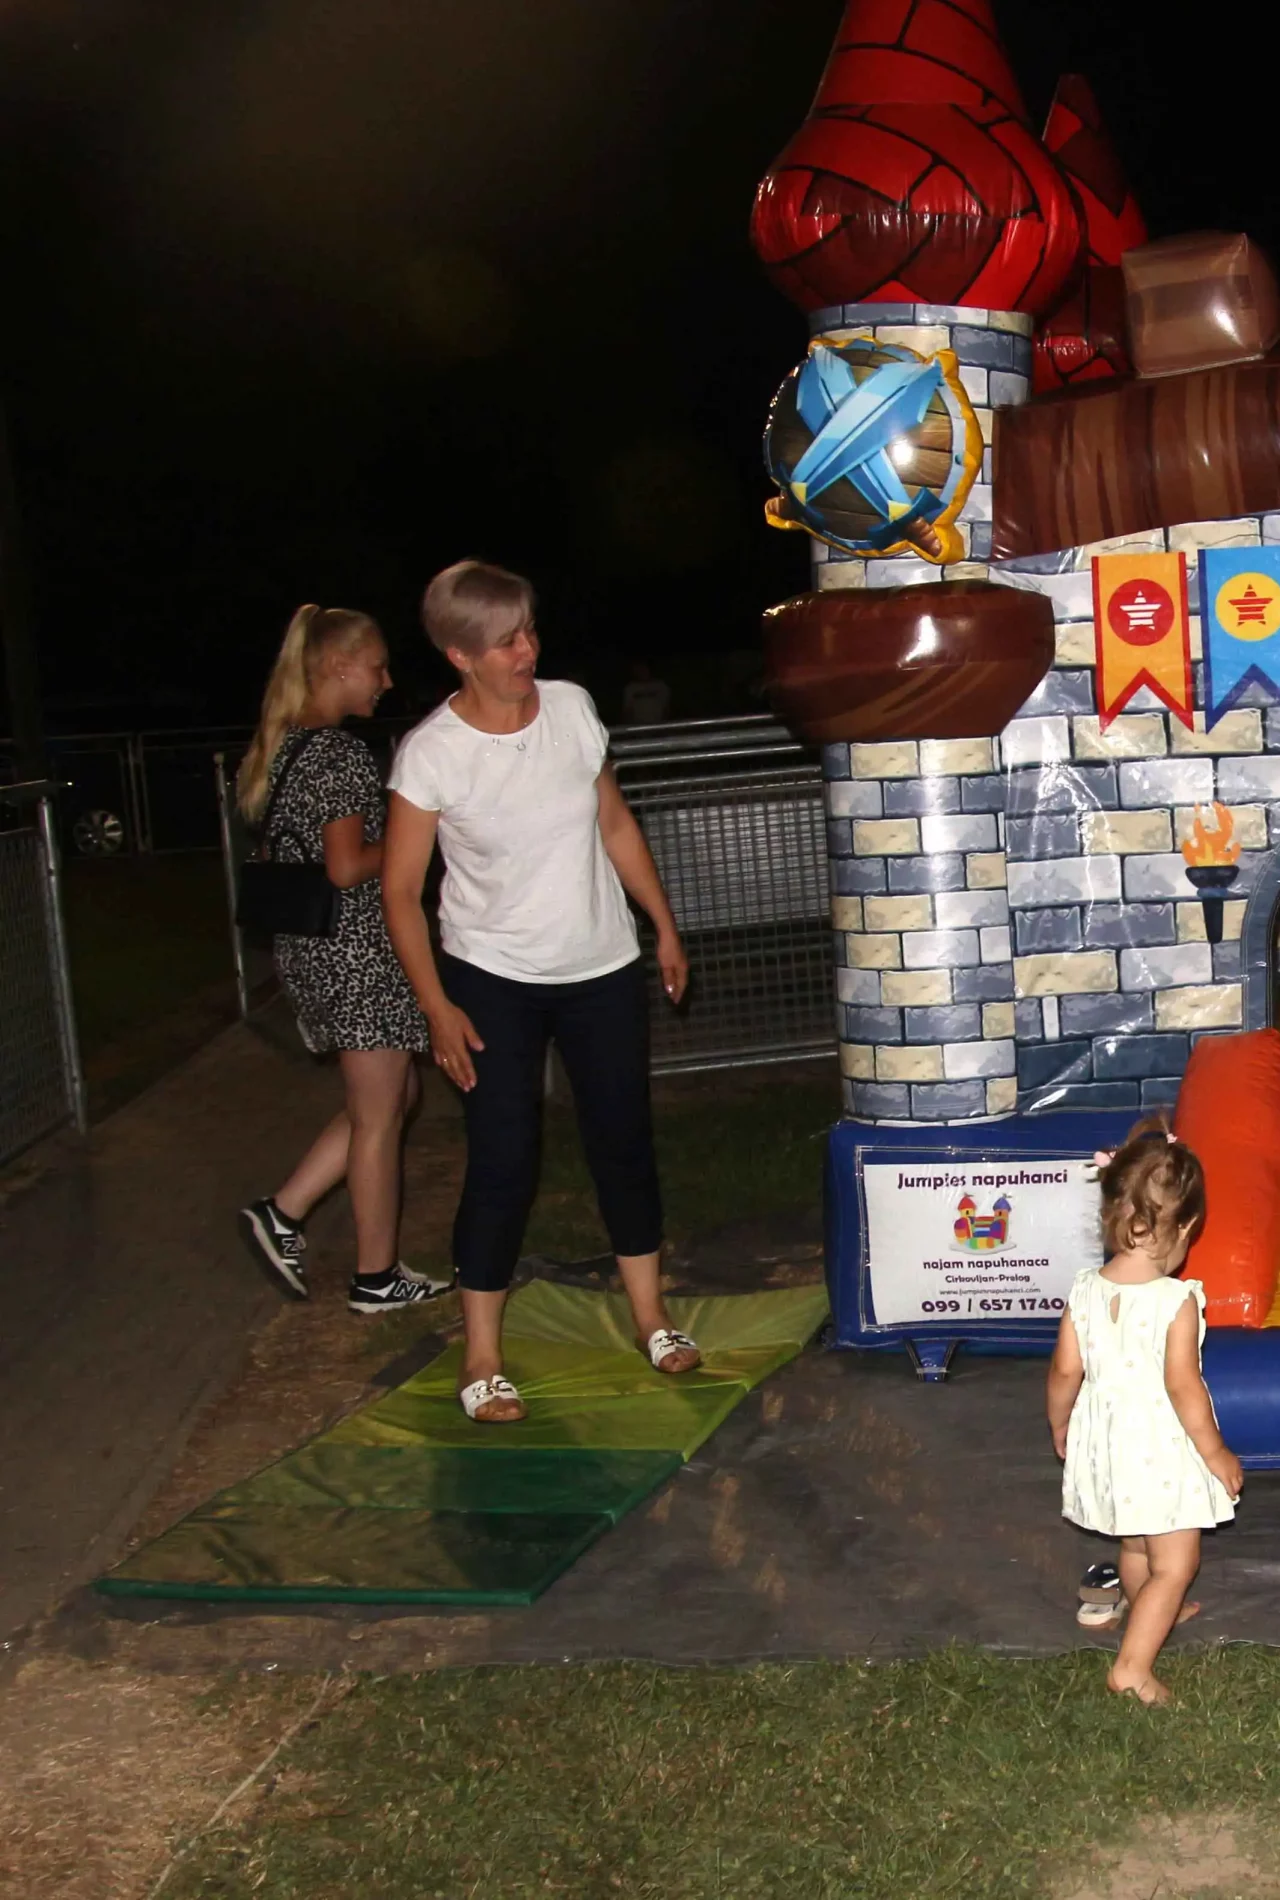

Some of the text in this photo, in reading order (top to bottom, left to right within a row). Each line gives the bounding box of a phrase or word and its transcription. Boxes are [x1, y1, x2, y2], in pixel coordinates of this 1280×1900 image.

[897, 1169, 1068, 1190] Jumpies napuhanci
[923, 1257, 1050, 1270] najam napuhanaca
[921, 1300, 960, 1312] 099
[979, 1298, 1013, 1311] 657
[1018, 1297, 1065, 1311] 1740
